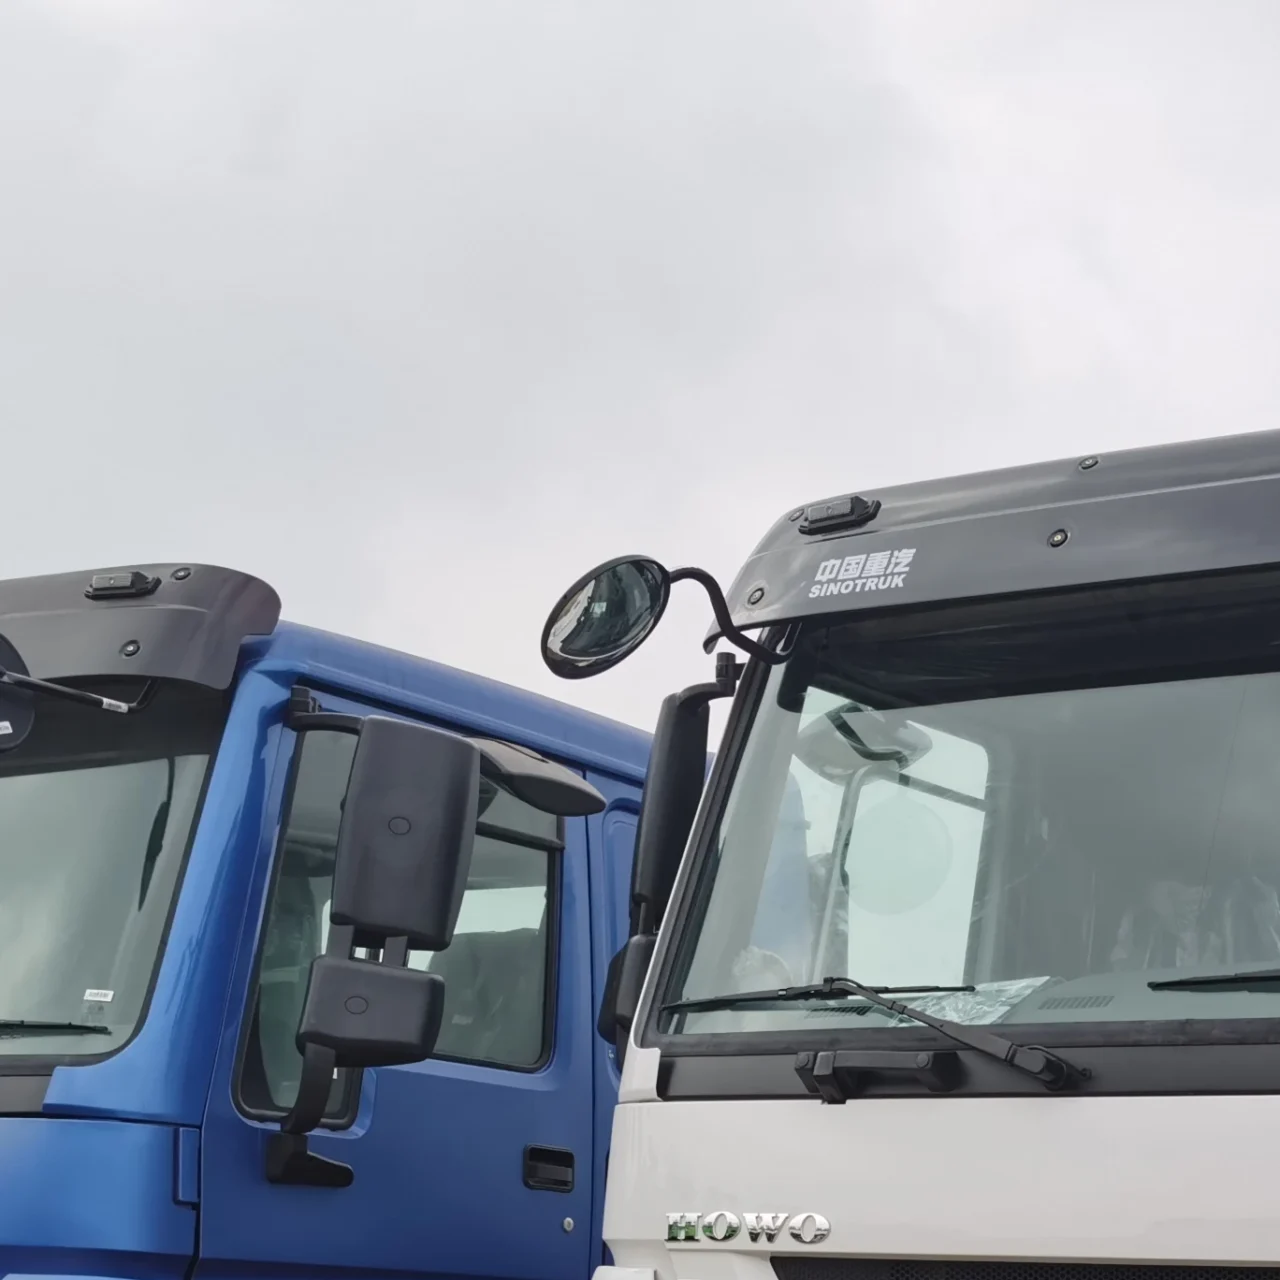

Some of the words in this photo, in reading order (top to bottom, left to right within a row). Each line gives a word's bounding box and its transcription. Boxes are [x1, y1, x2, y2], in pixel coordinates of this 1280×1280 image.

[814, 548, 917, 582] 中国重汽
[808, 574, 907, 598] SINOTRUK
[664, 1211, 832, 1245] HOWO
